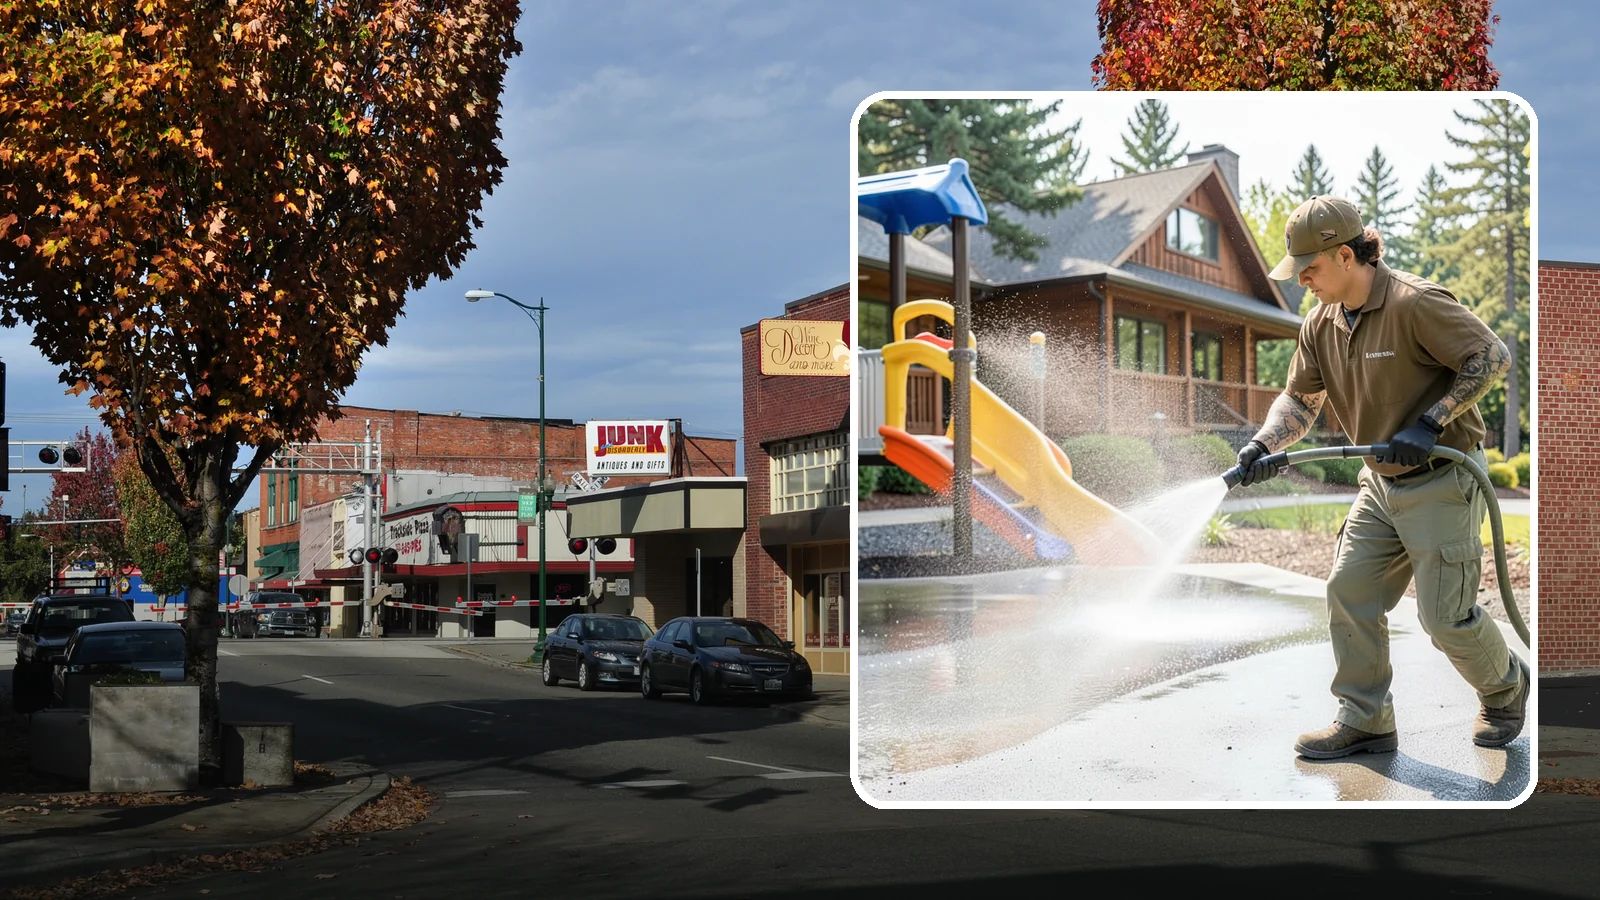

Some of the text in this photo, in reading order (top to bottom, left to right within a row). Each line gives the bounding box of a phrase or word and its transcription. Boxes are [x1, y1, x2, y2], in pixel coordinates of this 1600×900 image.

[595, 425, 665, 457] JUNK
[607, 446, 646, 454] DISORDERLY
[597, 460, 665, 470] ANTIQUES AND GIFTS
[414, 520, 429, 534] Pizza
